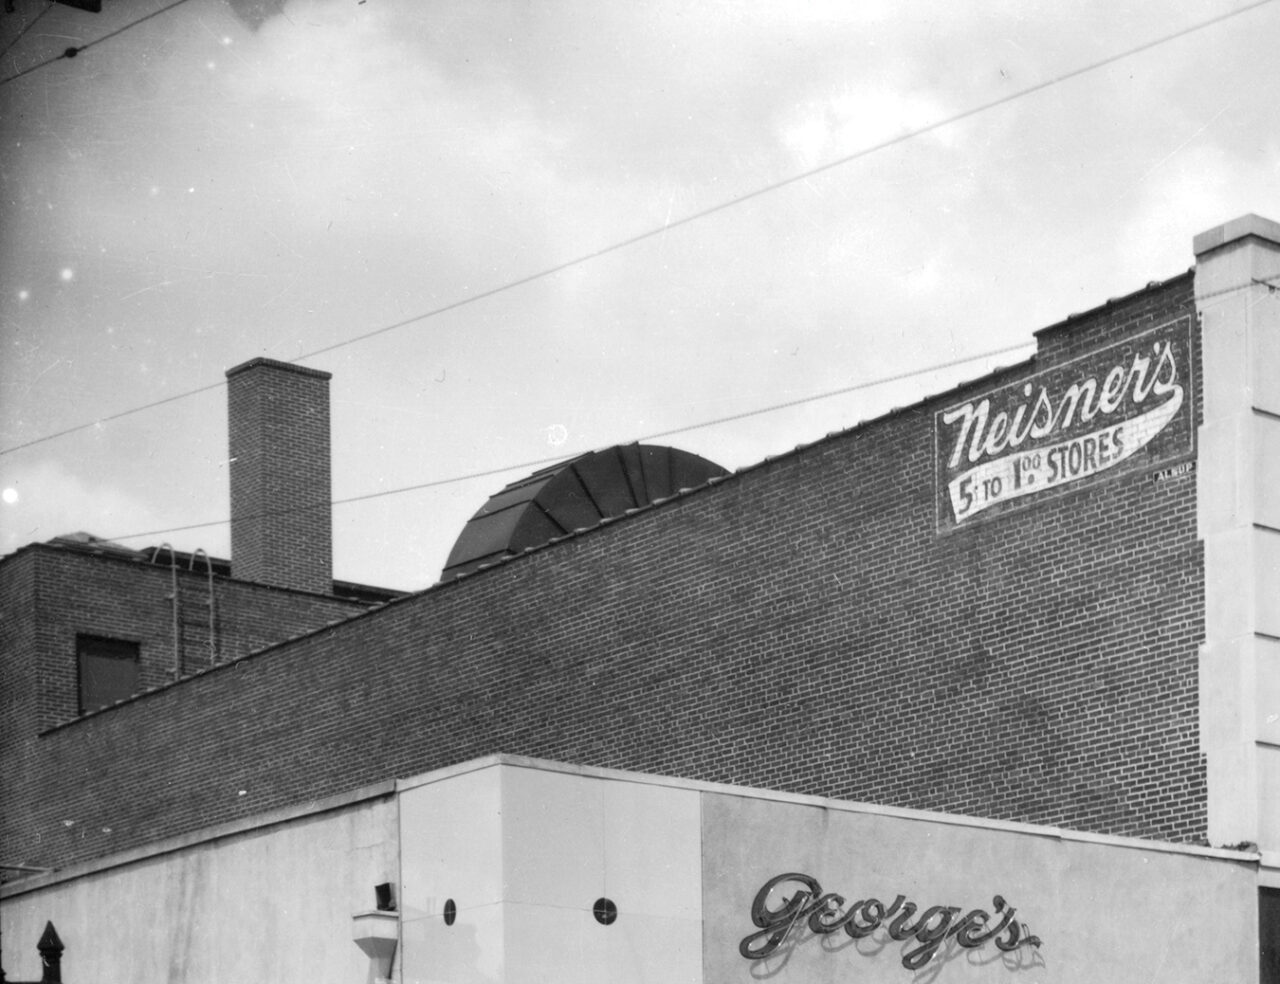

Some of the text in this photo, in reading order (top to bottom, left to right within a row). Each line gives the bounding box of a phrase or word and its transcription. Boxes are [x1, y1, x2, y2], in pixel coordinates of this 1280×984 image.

[943, 341, 1183, 468] Neisner's
[982, 476, 1002, 503] TO
[1047, 427, 1126, 484] STORES
[739, 872, 1042, 970] George's
